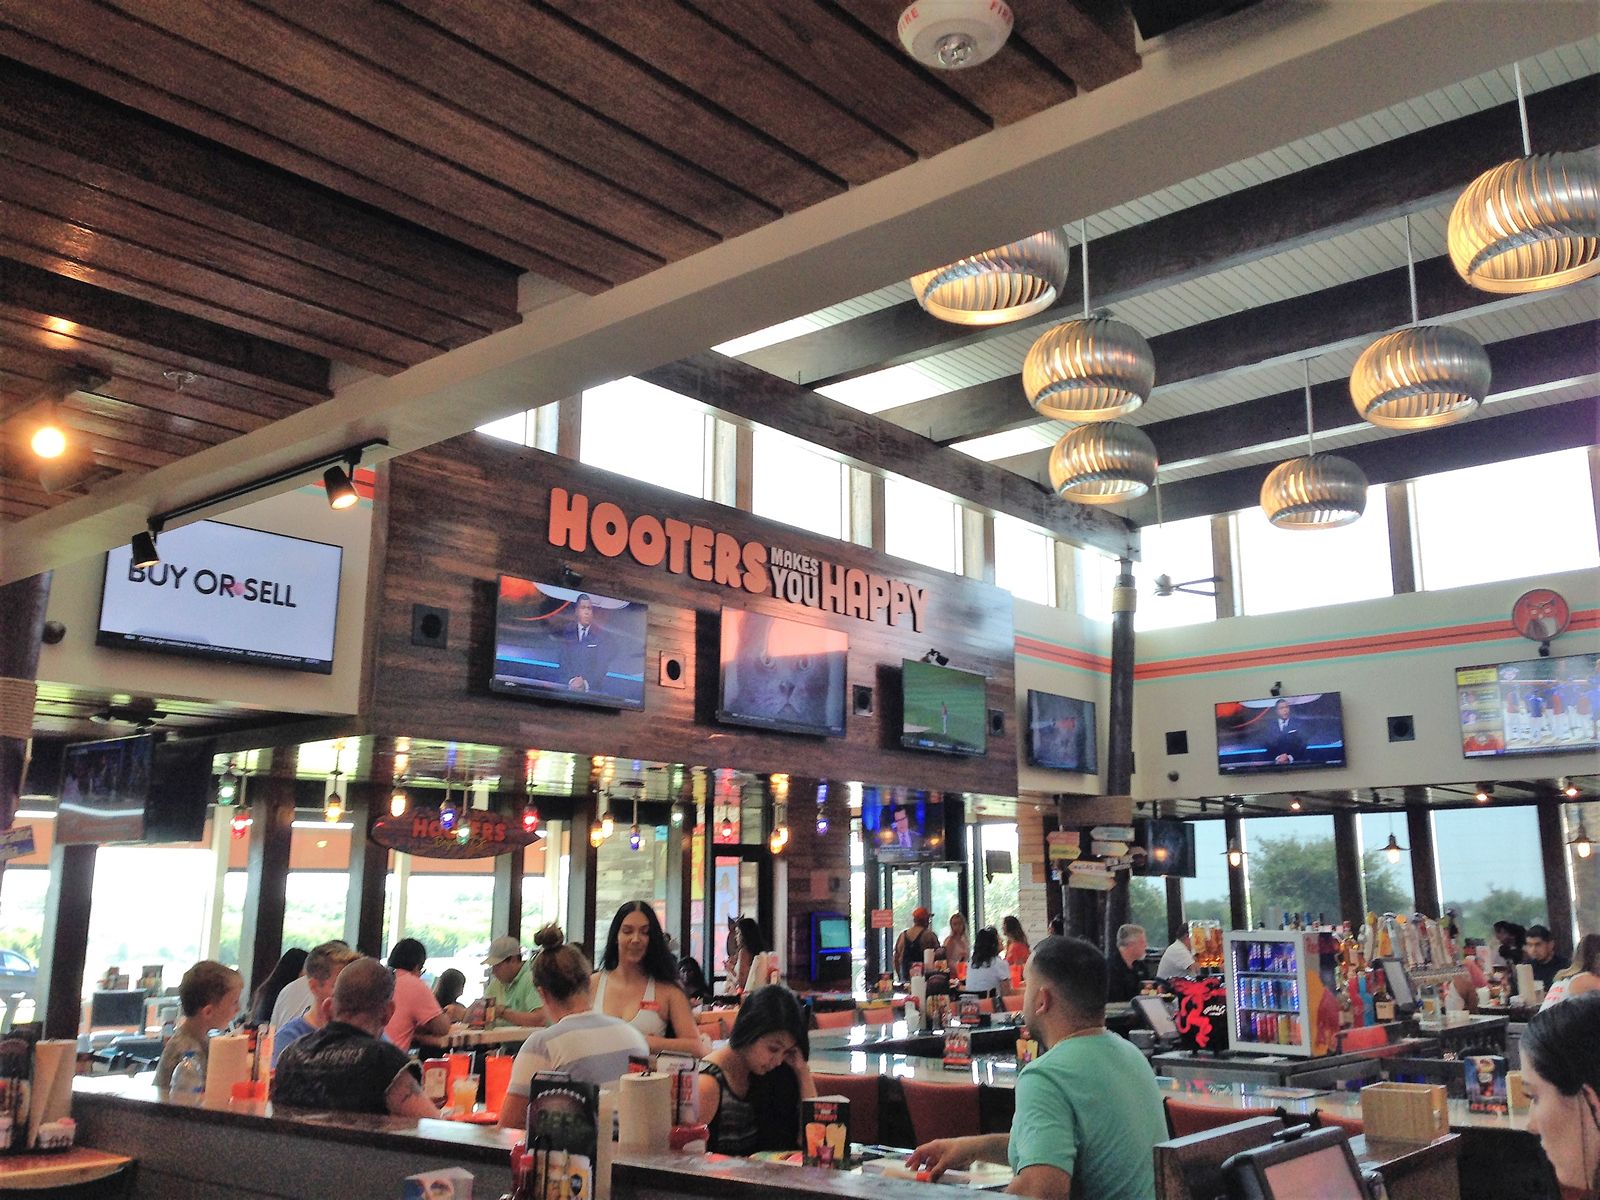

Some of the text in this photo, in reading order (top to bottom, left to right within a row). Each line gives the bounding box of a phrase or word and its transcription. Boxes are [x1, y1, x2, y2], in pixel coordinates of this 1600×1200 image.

[548, 487, 770, 594] HOOTERS
[770, 546, 819, 577] MAKES
[128, 558, 297, 608] BUY OR SELL
[771, 566, 820, 609] YOU
[820, 560, 930, 633] HAPPY
